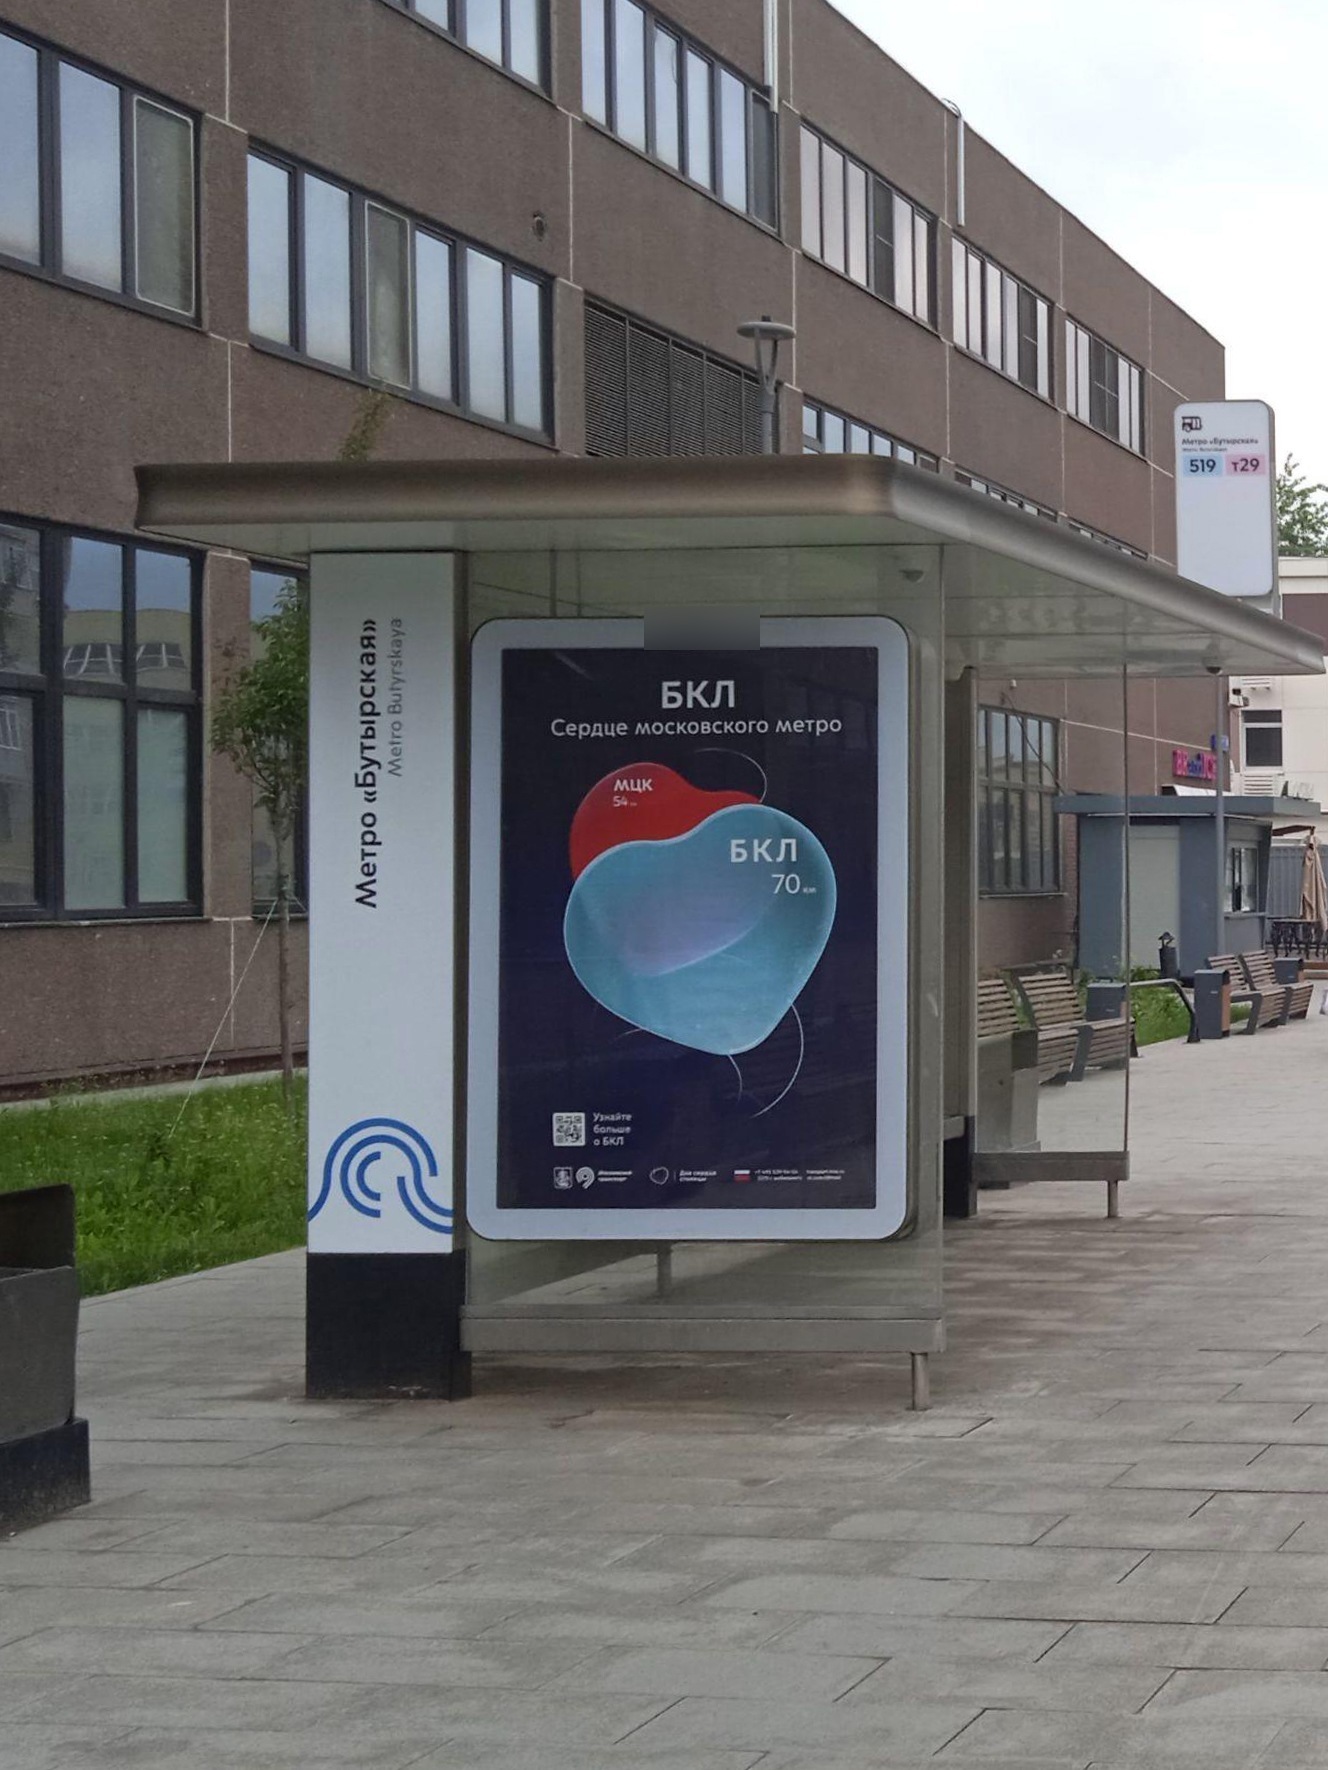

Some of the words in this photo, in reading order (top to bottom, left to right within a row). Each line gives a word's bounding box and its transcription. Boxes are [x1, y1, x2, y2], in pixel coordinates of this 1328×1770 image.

[1189, 458, 1217, 473] 519
[387, 617, 407, 715] Butyrskaya
[661, 679, 736, 709] БКЛ
[355, 618, 382, 804] «Бутырская»
[550, 718, 629, 739] Сердце
[634, 719, 769, 736] московского
[775, 718, 843, 737] метро
[388, 719, 403, 777] Metro
[613, 778, 653, 793] МЦК
[355, 811, 382, 908] Метро
[730, 838, 798, 863] БКЛ
[771, 873, 801, 895] 70
[593, 1112, 633, 1122] Узнайте
[593, 1124, 632, 1134] больше
[593, 1138, 601, 1146] о
[602, 1136, 625, 1146] БКЛ
